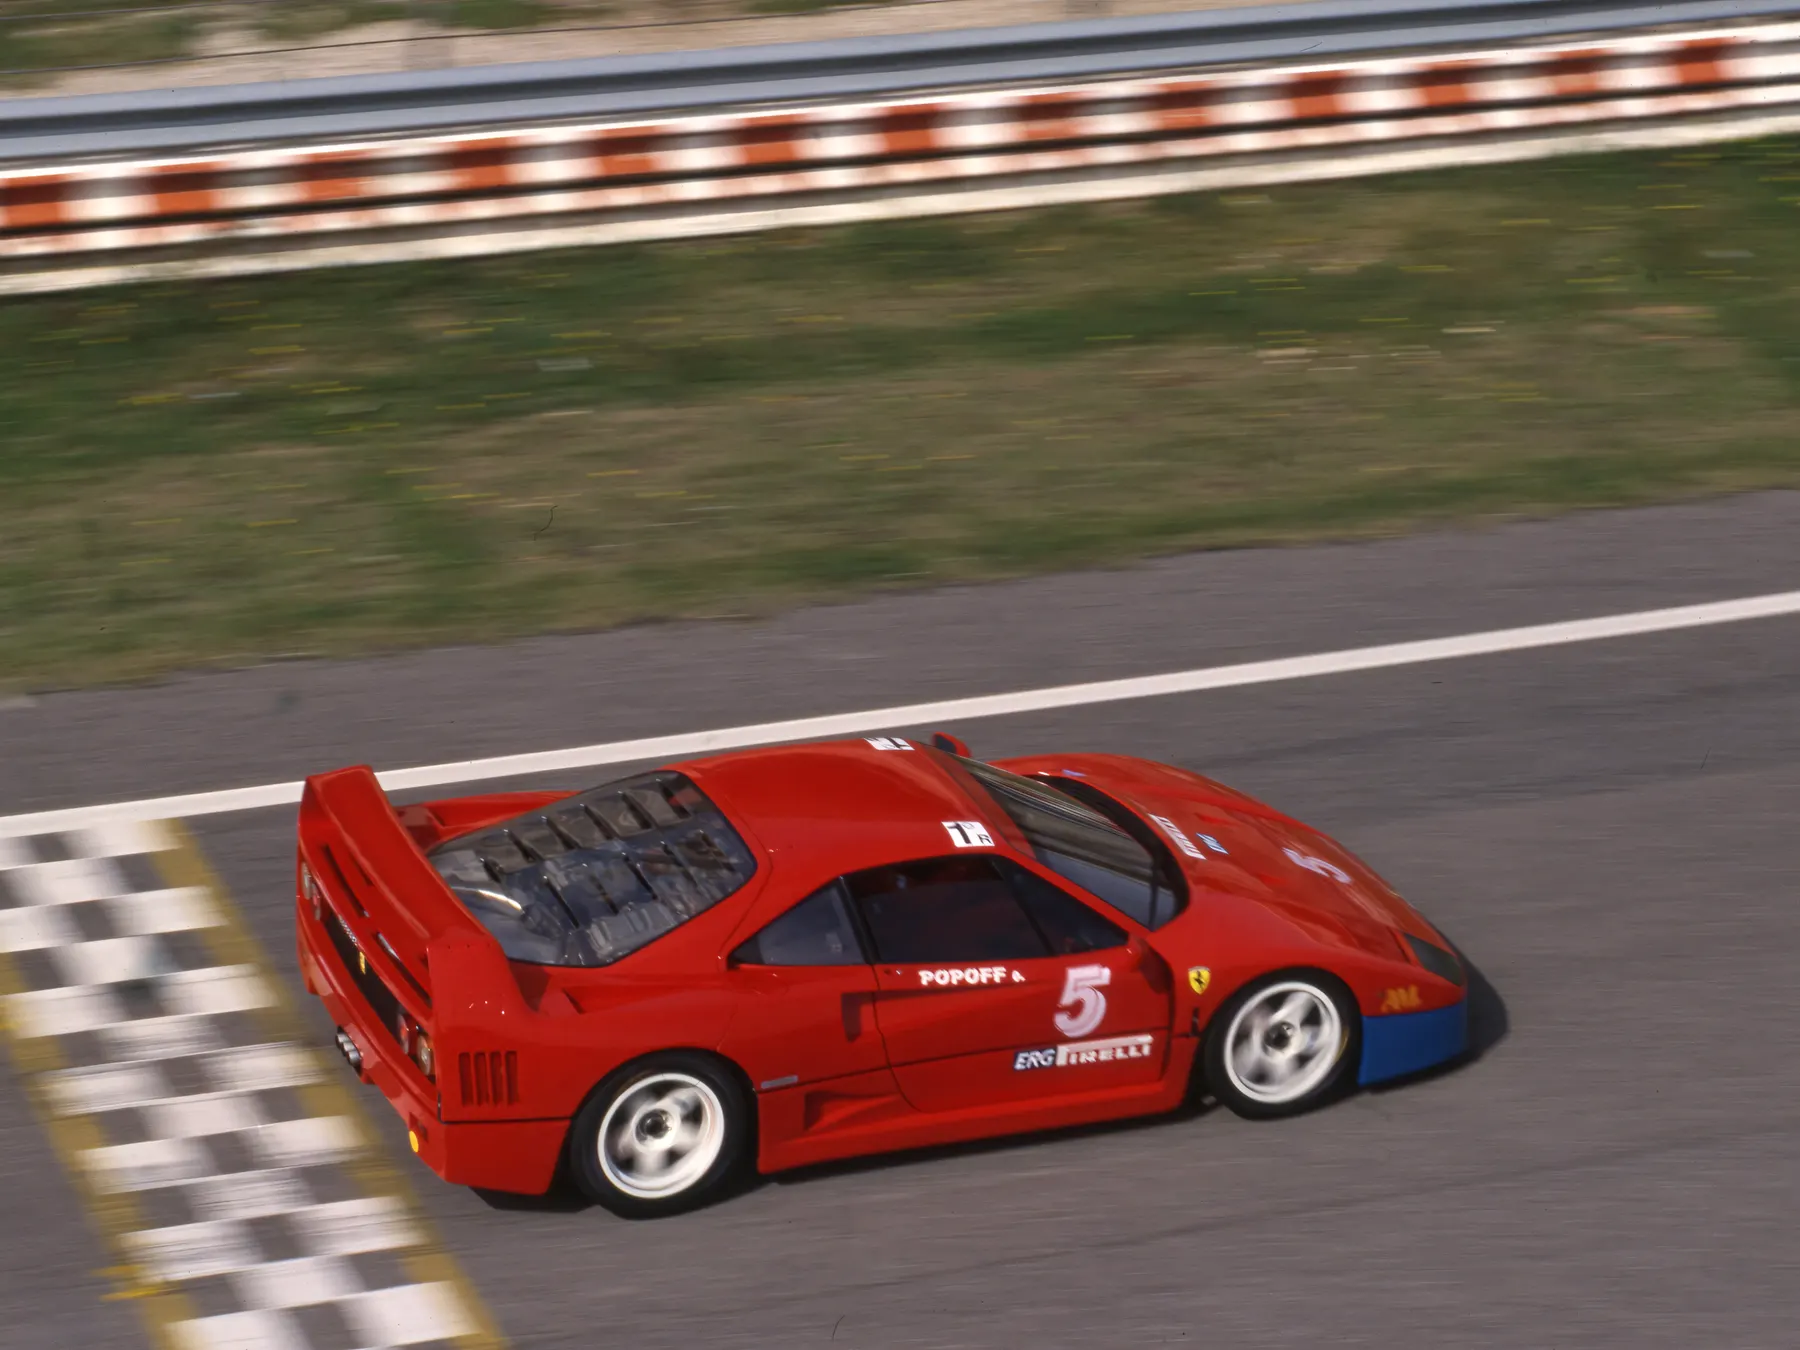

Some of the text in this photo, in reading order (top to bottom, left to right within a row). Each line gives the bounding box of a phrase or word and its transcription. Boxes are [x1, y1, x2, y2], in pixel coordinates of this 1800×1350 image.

[918, 966, 1007, 986] POPOFF
[1053, 964, 1111, 1038] 5
[1056, 1034, 1154, 1067] PIRELLI
